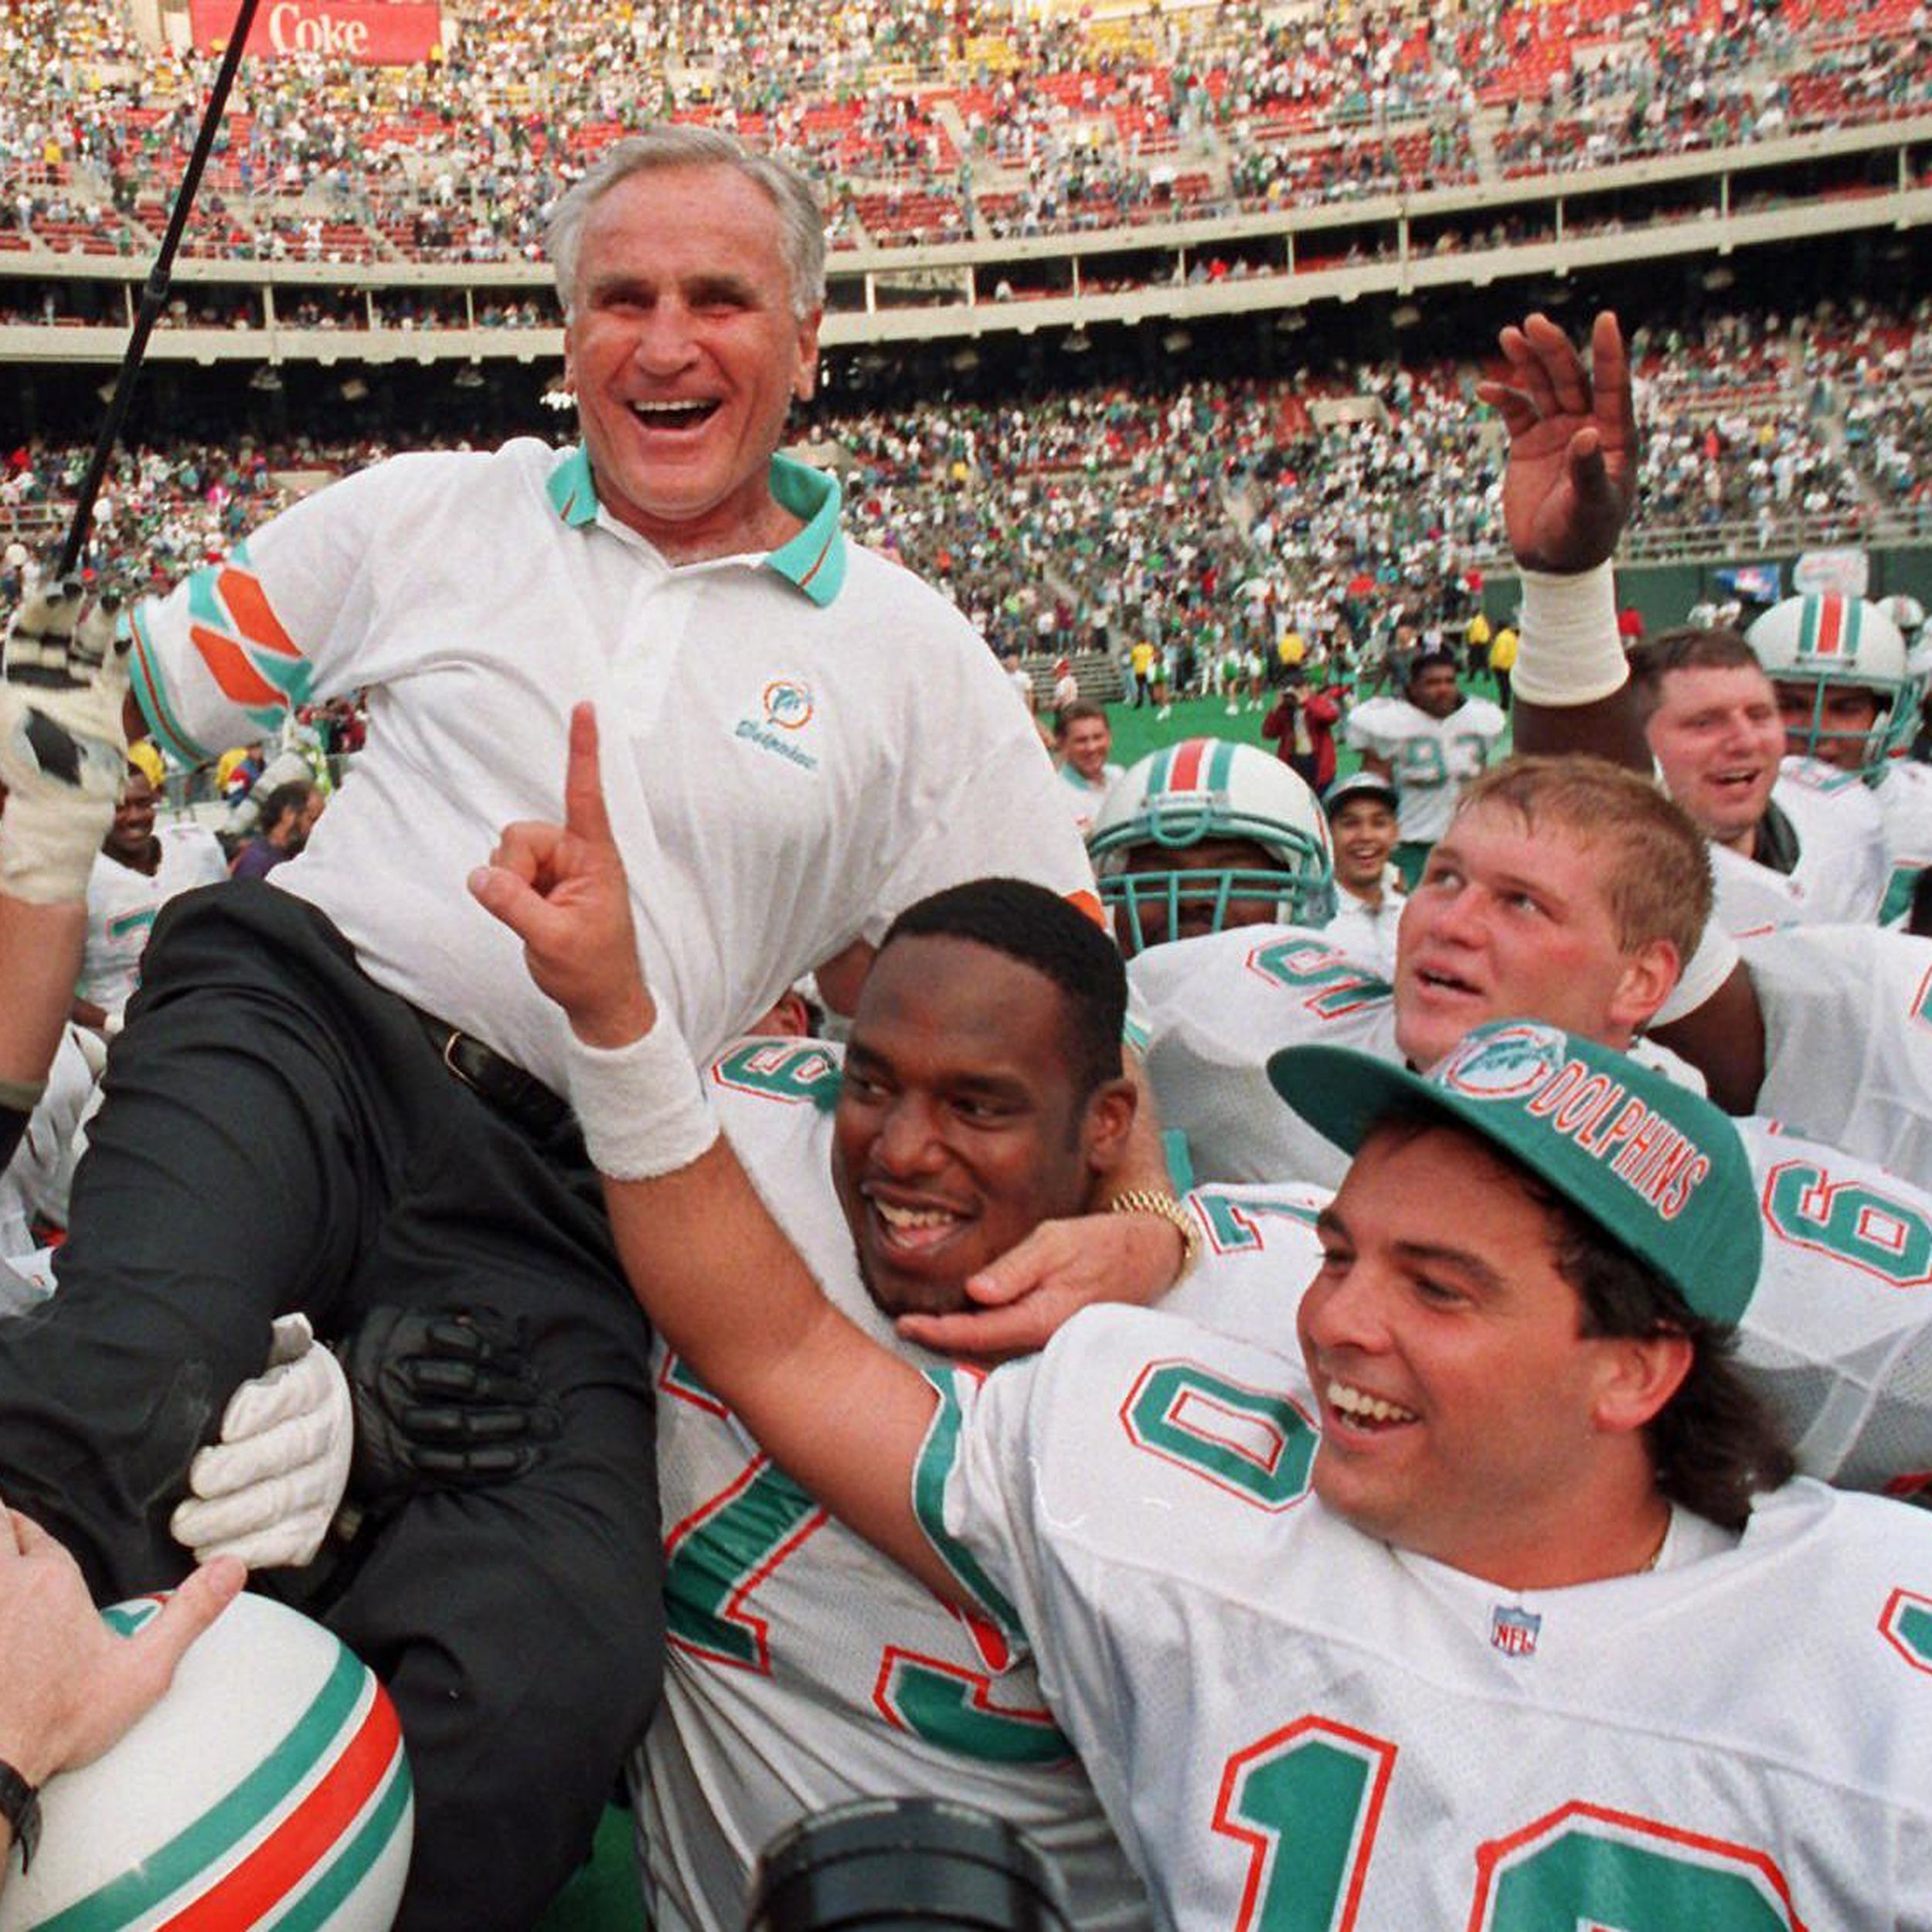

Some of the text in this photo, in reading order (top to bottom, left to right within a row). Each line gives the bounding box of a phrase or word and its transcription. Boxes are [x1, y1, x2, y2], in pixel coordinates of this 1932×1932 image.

[269, 2, 369, 56] Coke
[1525, 1058, 1710, 1220] DOLPHINS
[1496, 1621, 1536, 1654] NFL
